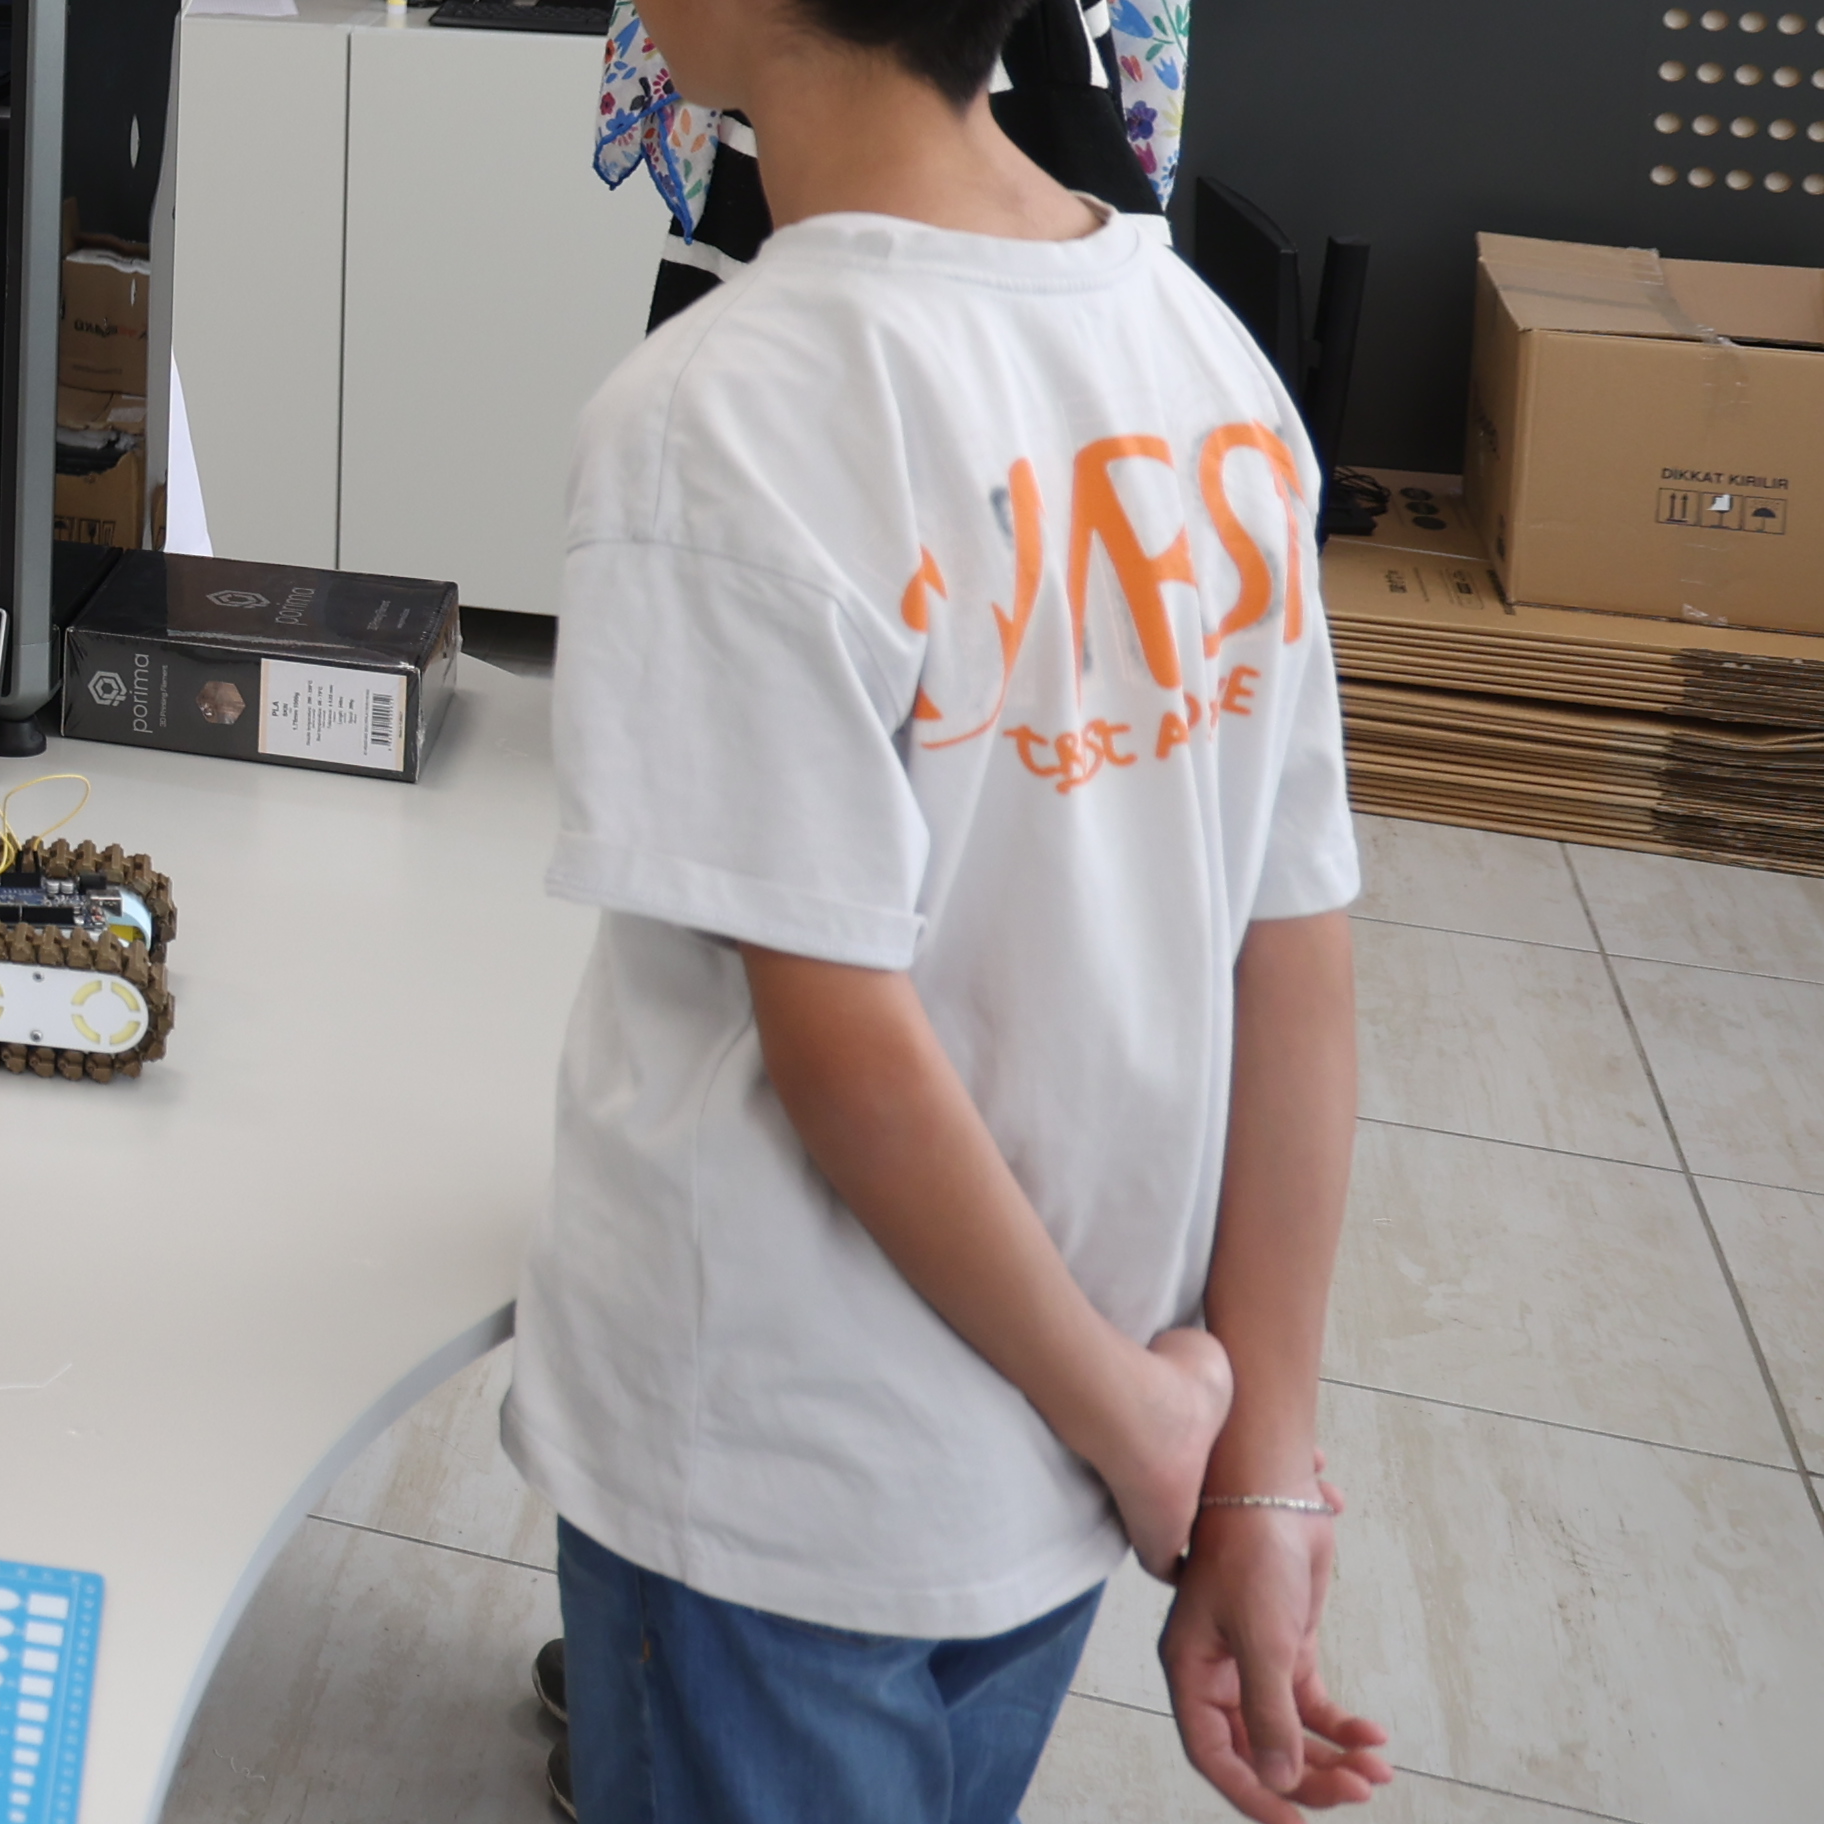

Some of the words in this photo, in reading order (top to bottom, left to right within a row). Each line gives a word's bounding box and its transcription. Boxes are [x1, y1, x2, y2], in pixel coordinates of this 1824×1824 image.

[275, 587, 316, 626] porima
[129, 653, 153, 734] porima
[271, 700, 279, 717] PLA
